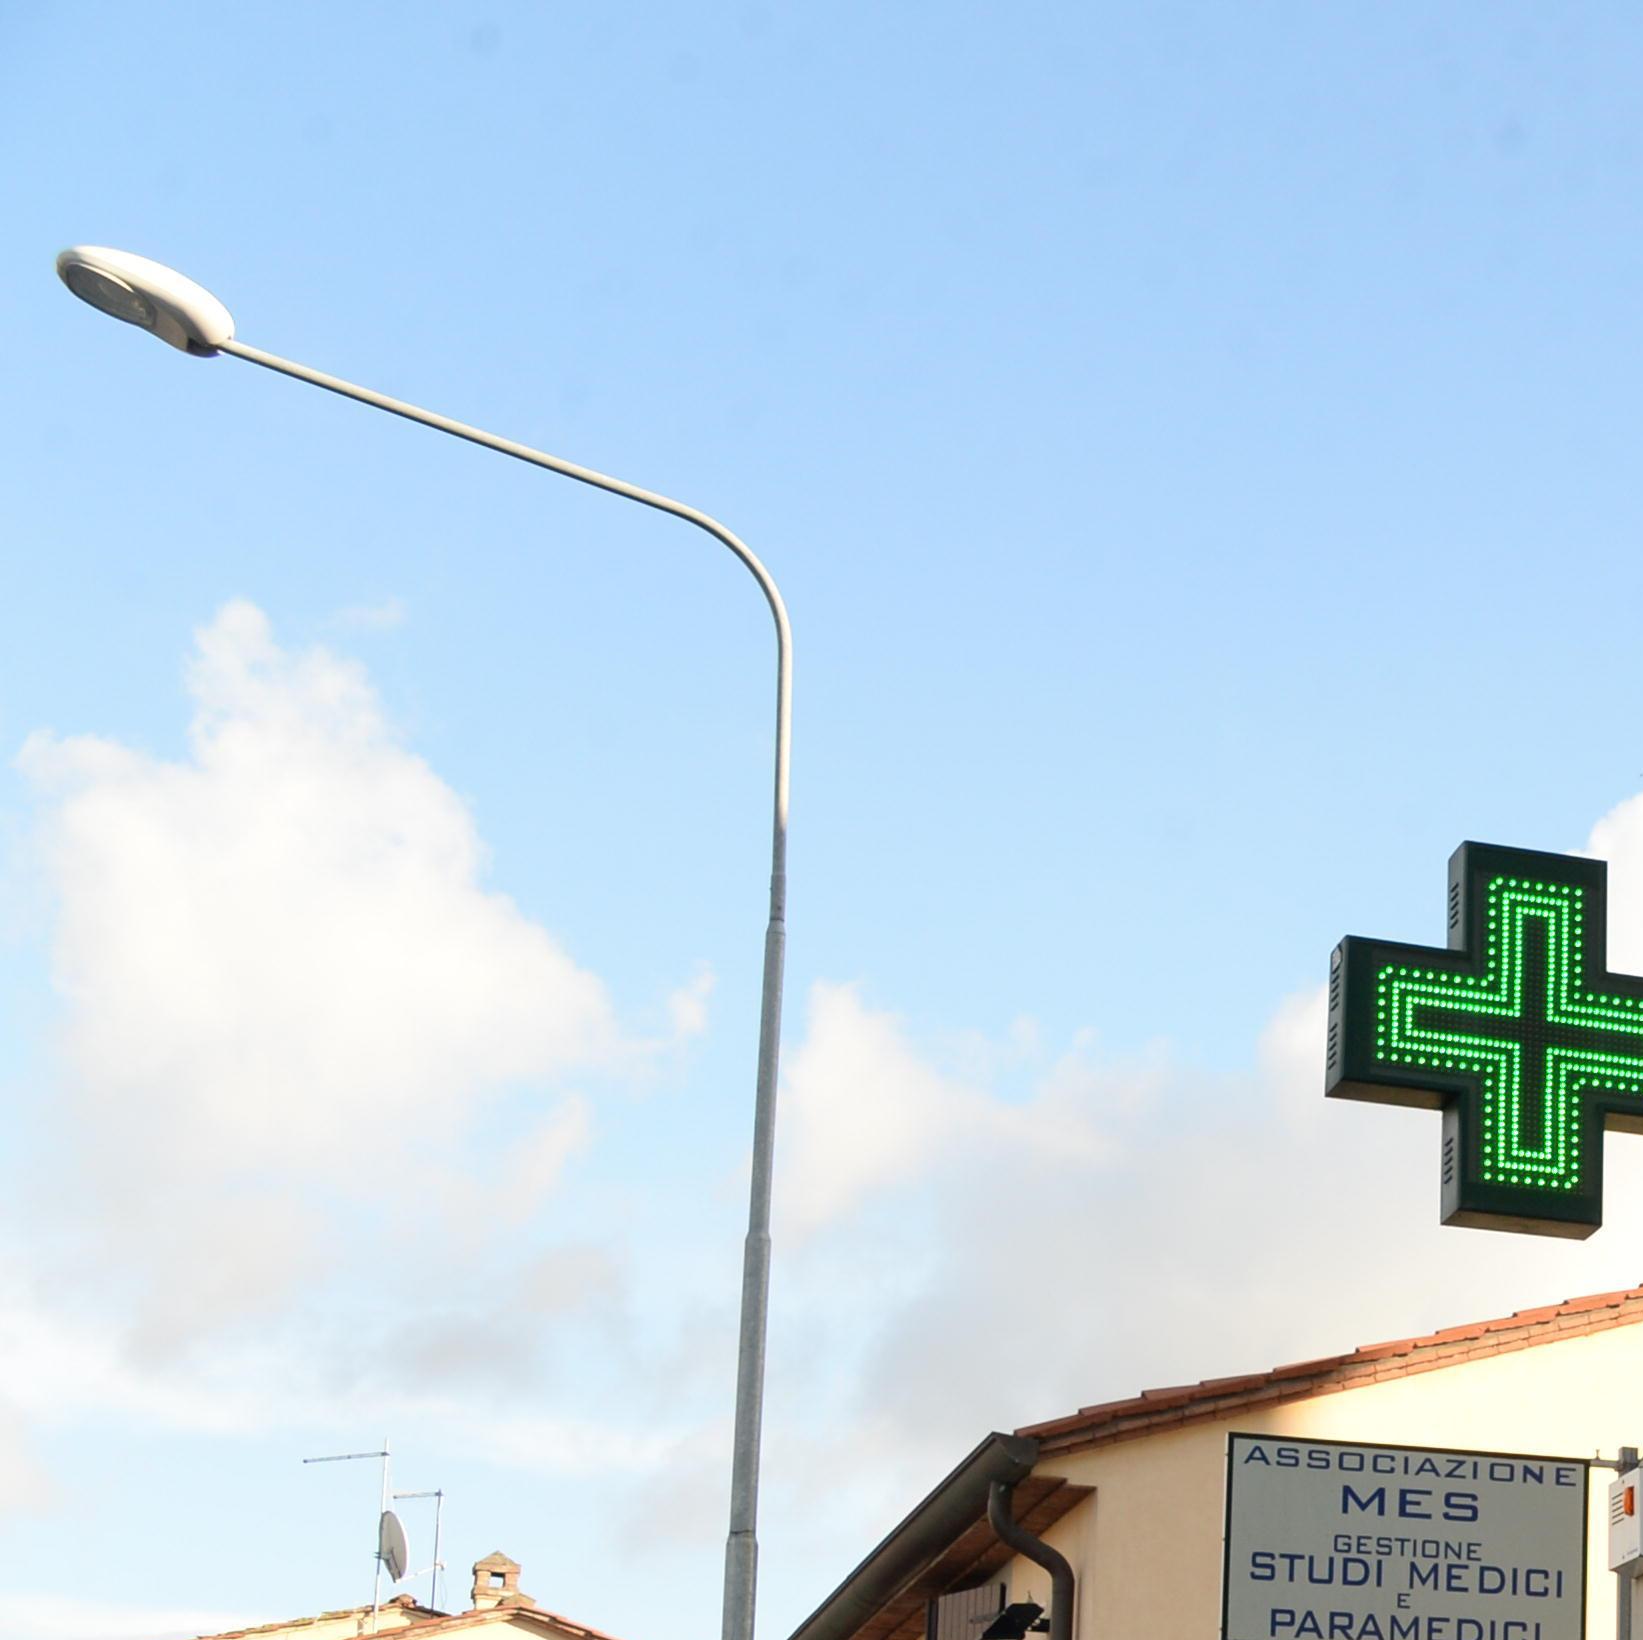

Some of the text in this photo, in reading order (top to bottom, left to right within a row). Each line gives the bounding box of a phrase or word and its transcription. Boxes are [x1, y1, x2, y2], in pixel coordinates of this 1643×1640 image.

[1243, 1445, 1578, 1488] ASSOCIAZIONE
[1341, 1484, 1480, 1524] MES
[1334, 1534, 1482, 1562] GESTIONE
[1249, 1551, 1564, 1600] STUDI MEDICI
[1397, 1593, 1411, 1609] E
